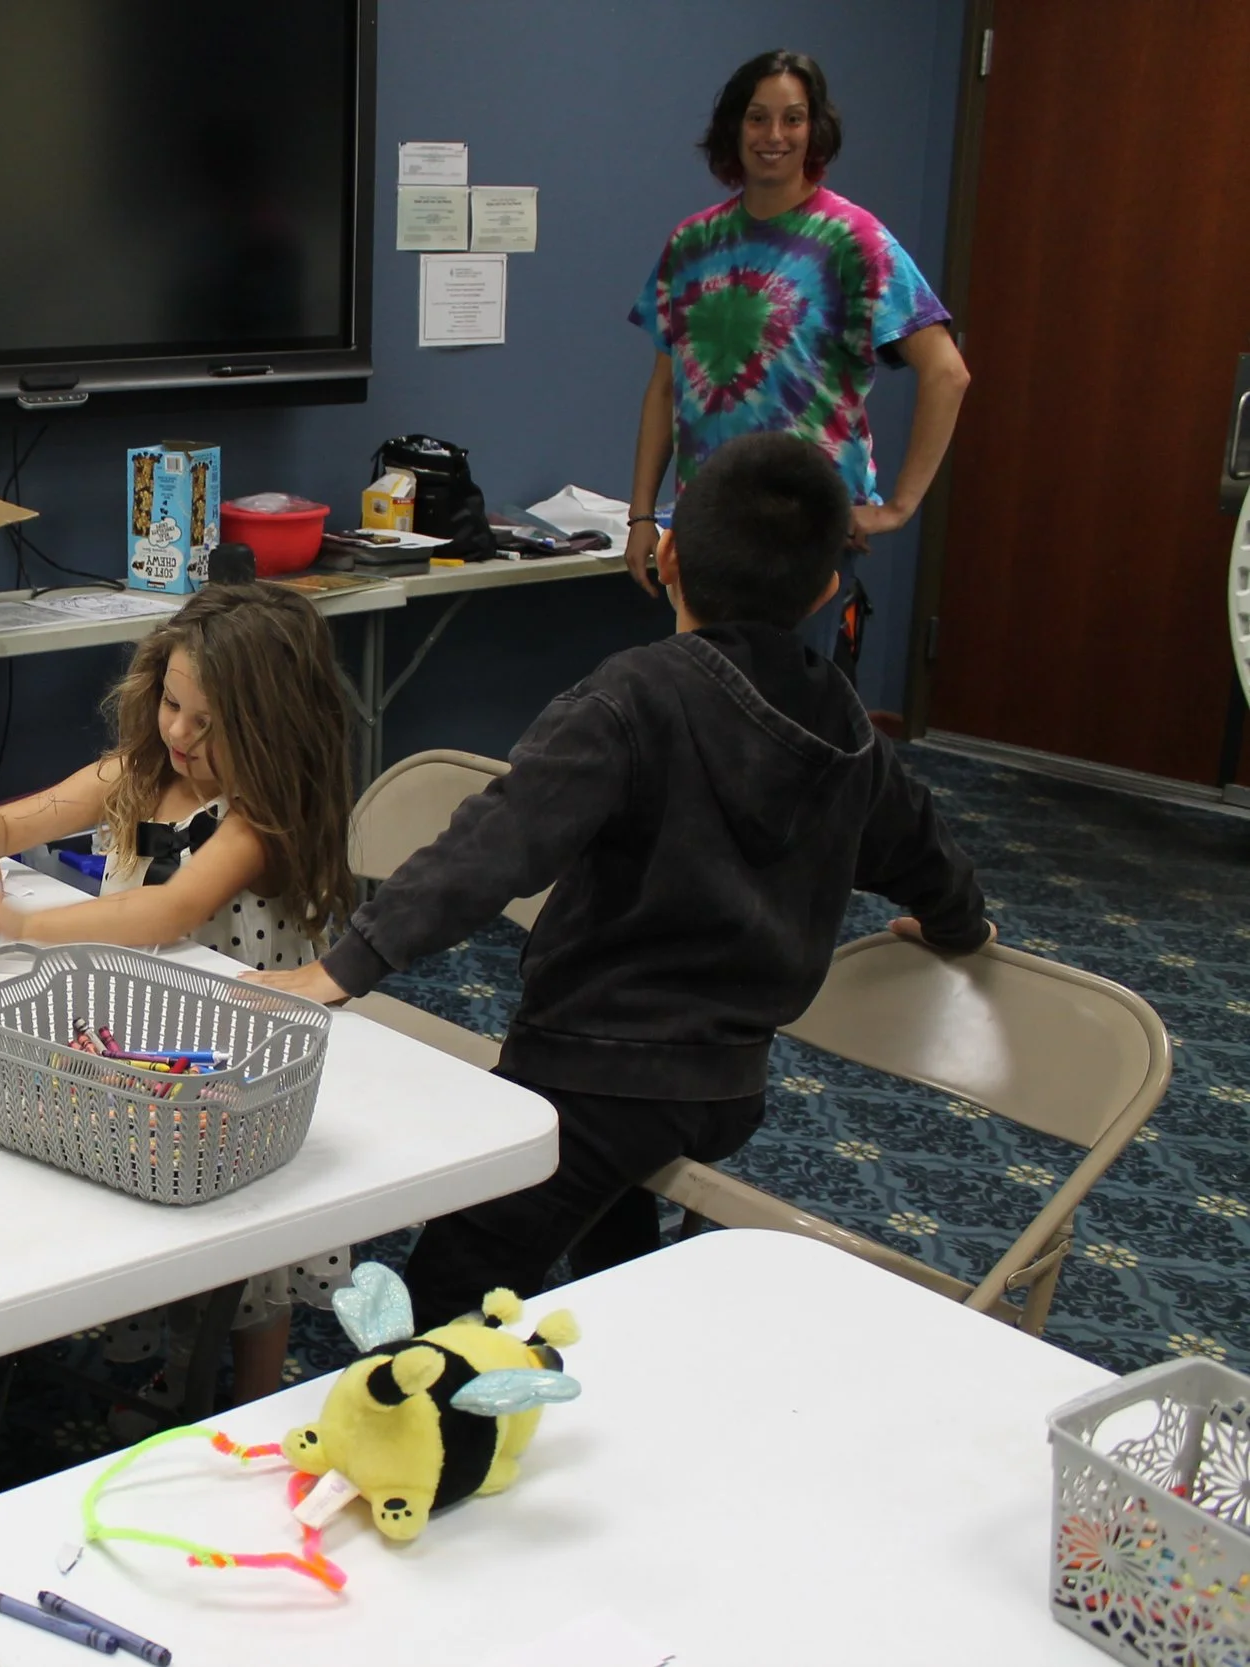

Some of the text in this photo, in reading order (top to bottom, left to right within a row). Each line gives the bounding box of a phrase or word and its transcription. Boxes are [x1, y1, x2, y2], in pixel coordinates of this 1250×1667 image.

[146, 555, 177, 568] CHEWY
[145, 567, 173, 578] SOFT &
